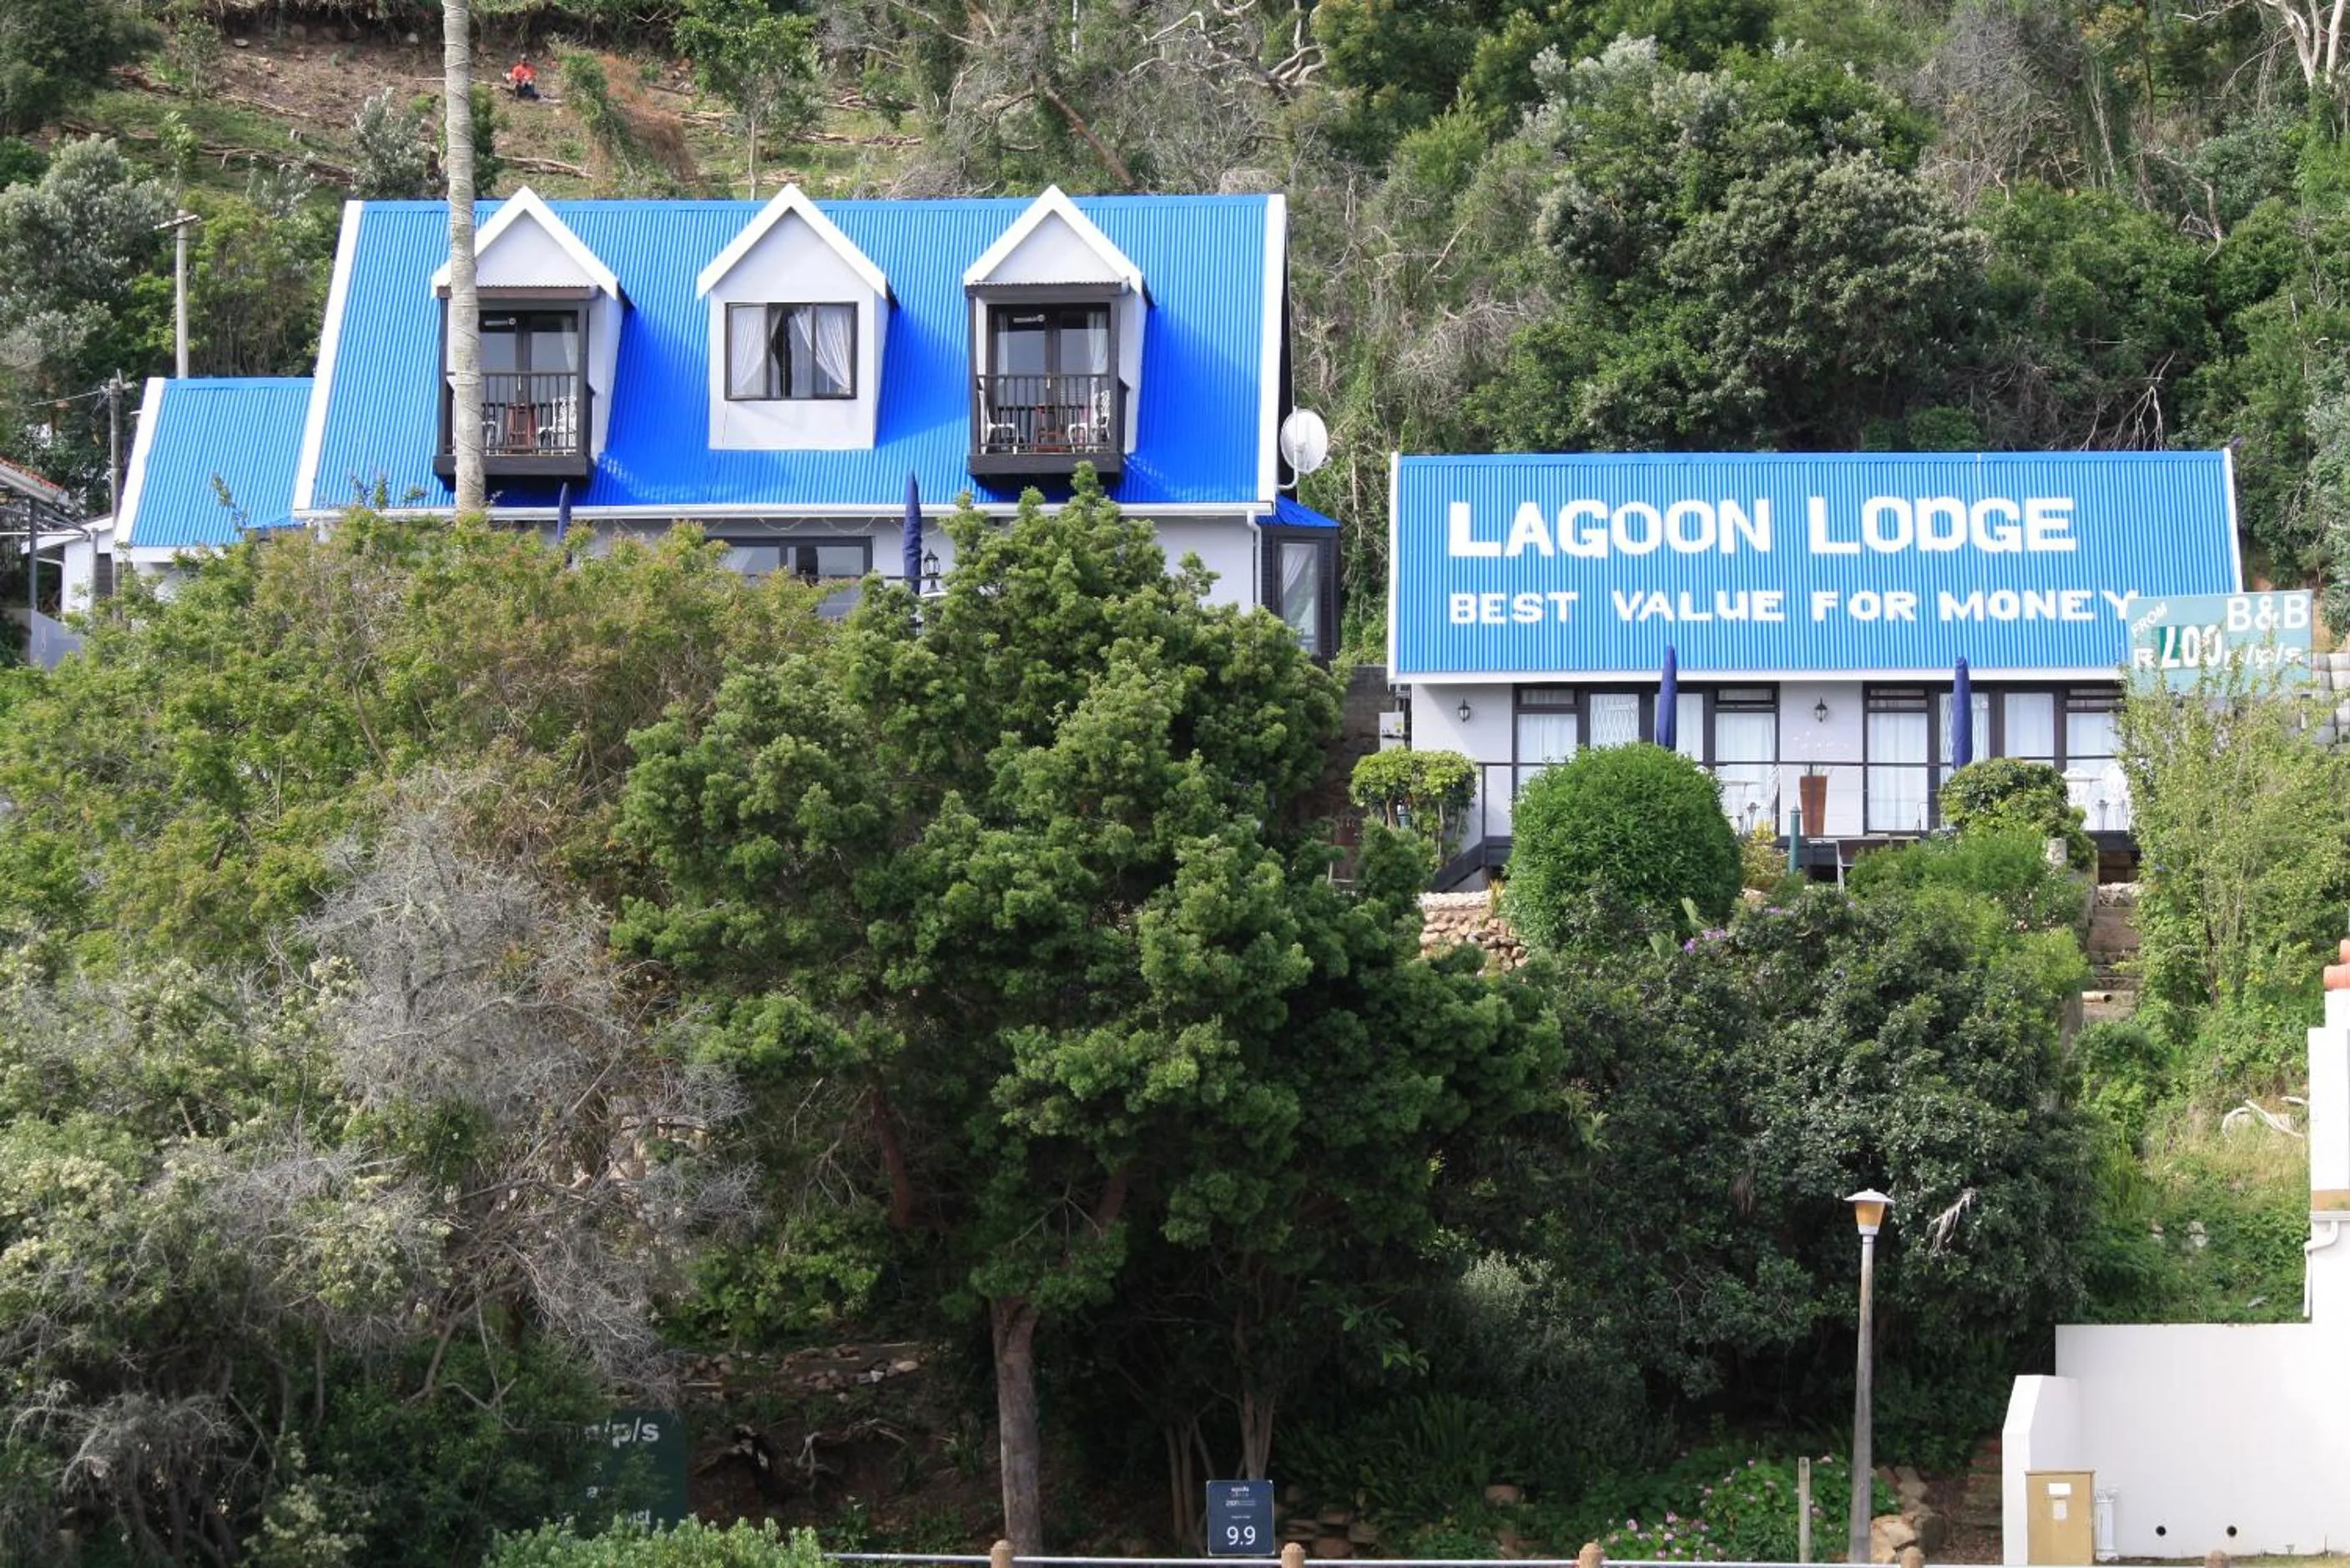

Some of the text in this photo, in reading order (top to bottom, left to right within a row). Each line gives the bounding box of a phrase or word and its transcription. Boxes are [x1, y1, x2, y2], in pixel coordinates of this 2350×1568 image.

[1448, 496, 2077, 558] LAGOON LODGE
[1450, 588, 2140, 625] BEST VALUE FOR MONEY
[2131, 601, 2169, 638] FROM
[2226, 594, 2310, 632] B&B
[1226, 1525, 1256, 1545] 9.9
